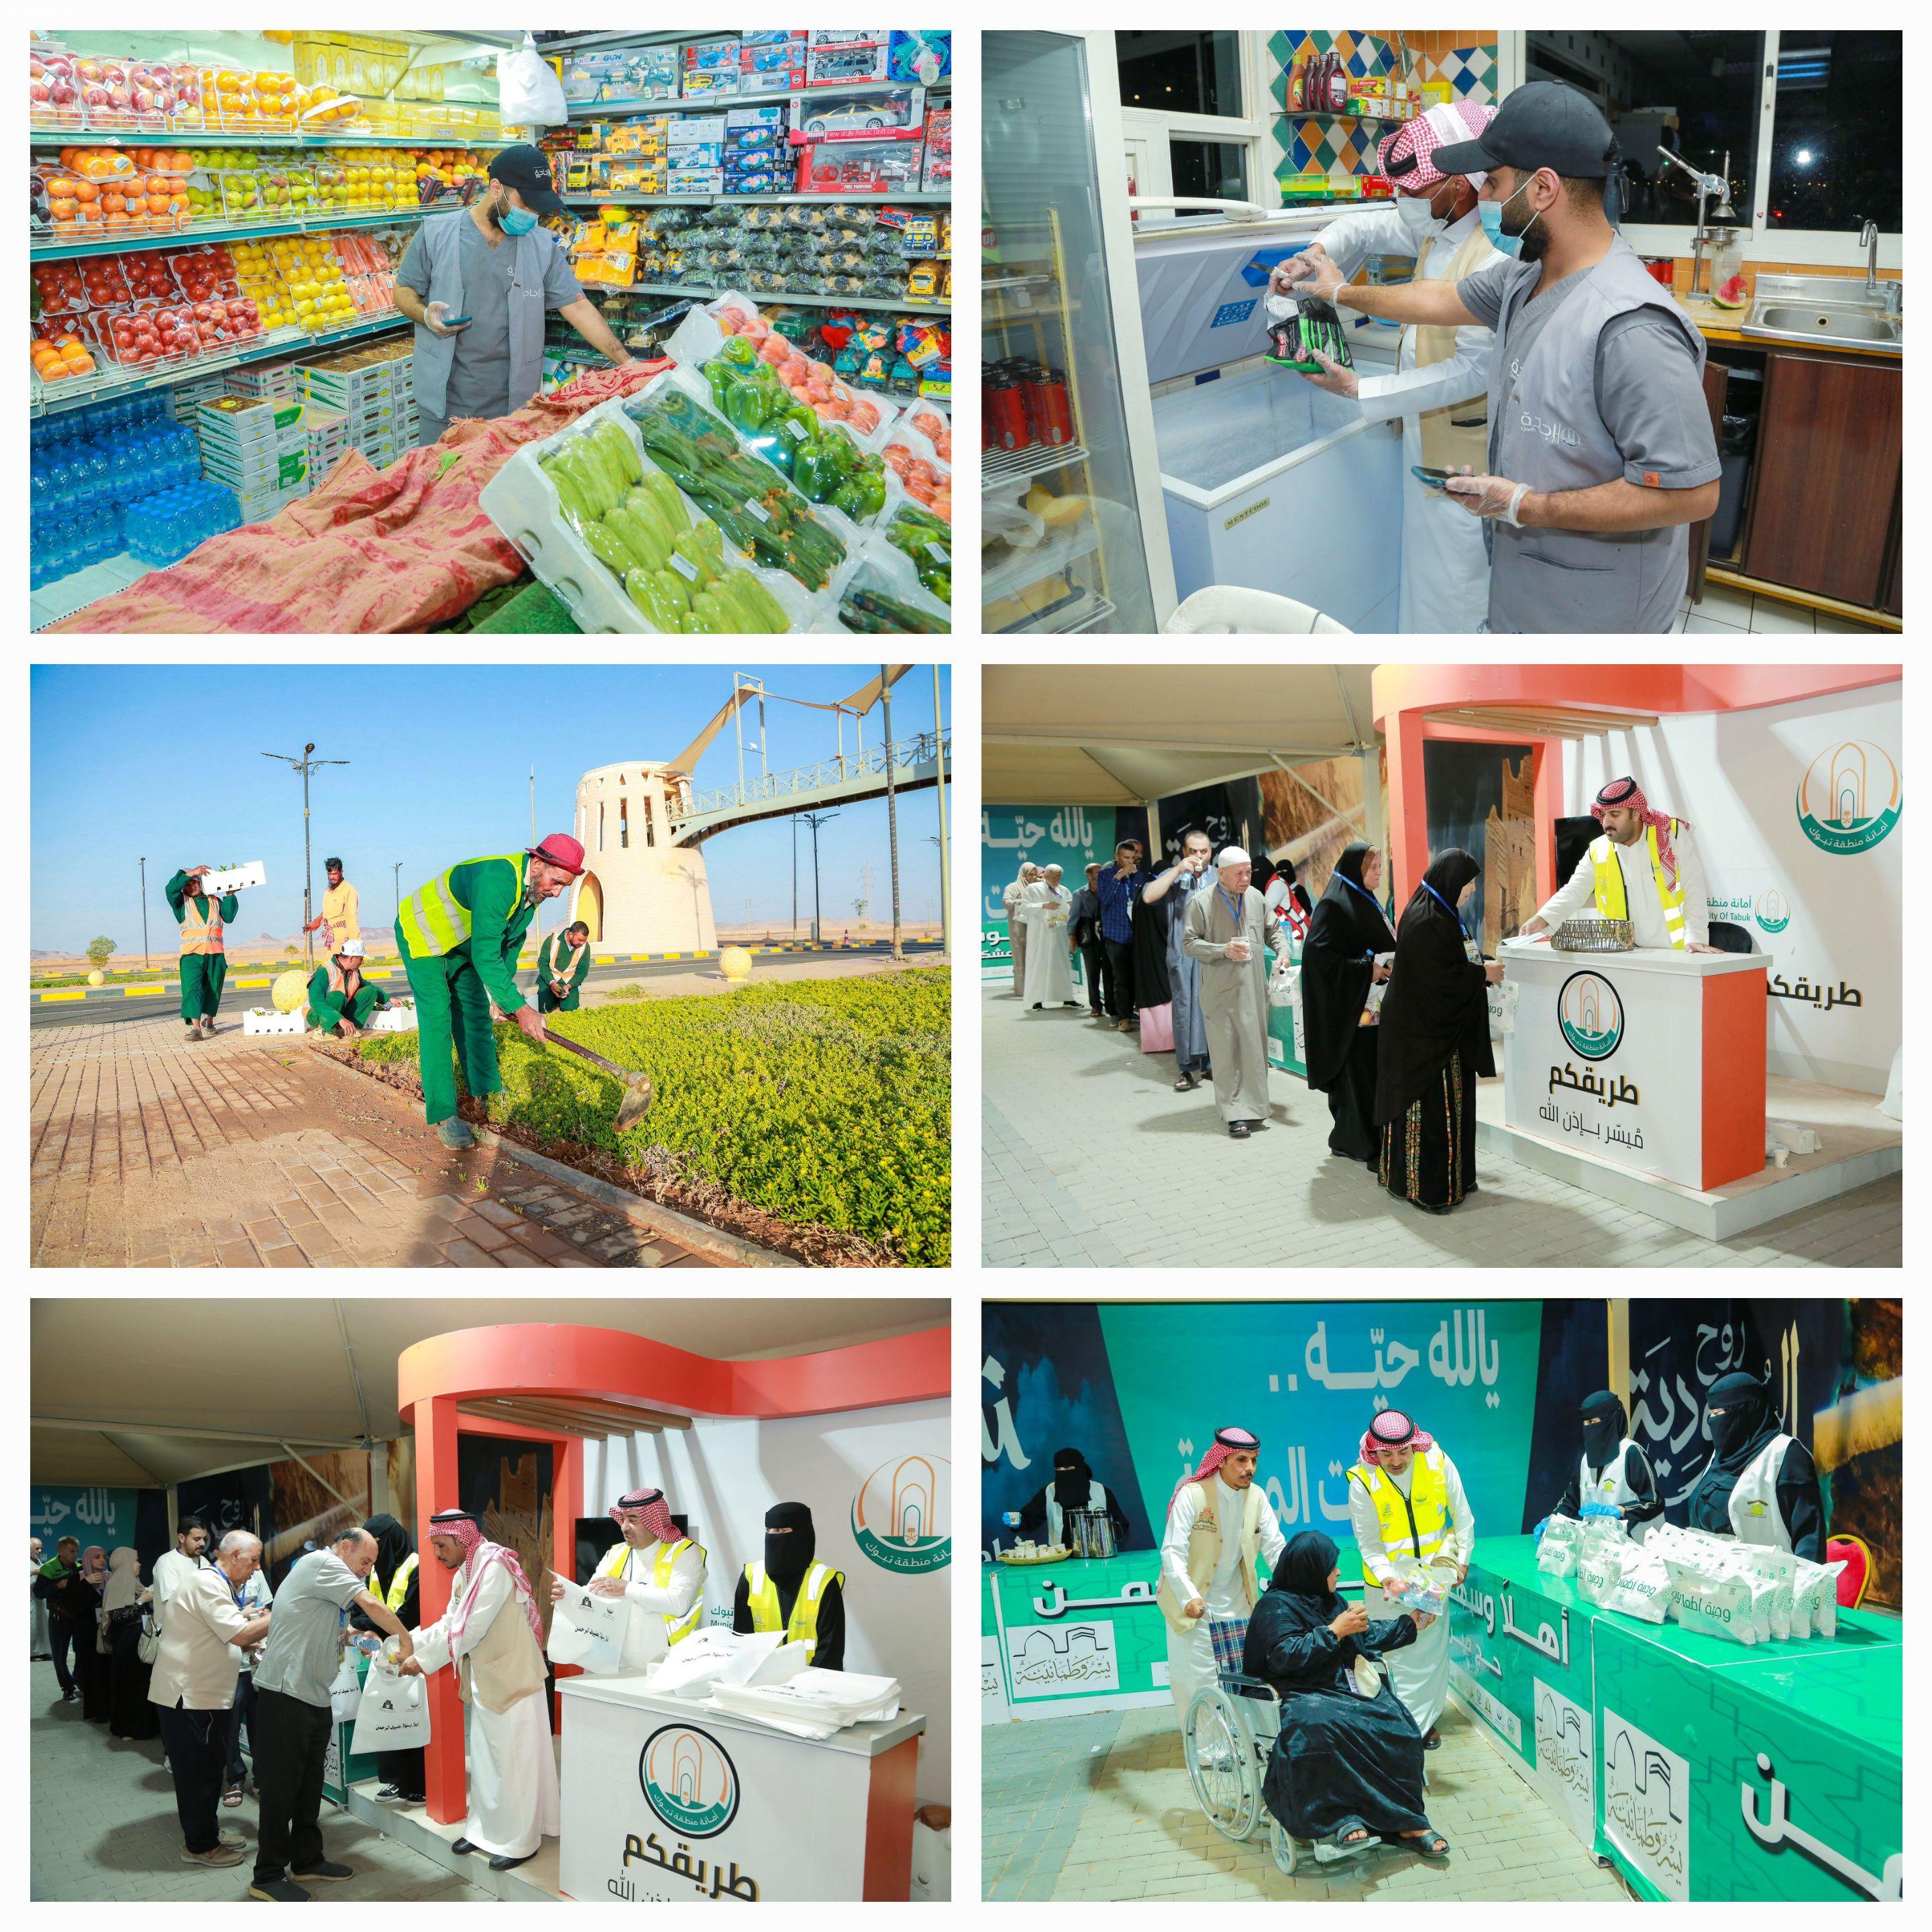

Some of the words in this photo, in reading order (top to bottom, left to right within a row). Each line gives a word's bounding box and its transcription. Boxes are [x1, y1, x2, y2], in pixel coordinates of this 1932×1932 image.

[1809, 825, 1833, 848] تبوك
[1865, 818, 1888, 843] أمانة
[1833, 836, 1864, 849] منطقة
[1731, 895, 1752, 909] أمانة
[1719, 912, 1729, 920] Of
[1730, 912, 1751, 922] Tabuk
[1767, 974, 1864, 1011] طريقك
[1568, 1030, 1583, 1046] تبوك
[1582, 1042, 1599, 1051] منطقة
[1599, 1035, 1612, 1050] أمانة
[1548, 1062, 1641, 1108] طريقكم
[1539, 1096, 1560, 1124] الله
[1428, 1308, 1501, 1409] يالله
[865, 1542, 894, 1563] تبوك
[894, 1555, 930, 1567] منطقة
[1587, 1570, 1604, 1589] وجبة
[1637, 1580, 1657, 1598] وجبة
[711, 1605, 735, 1619] تبوك
[1705, 1601, 1731, 1623] وجبة
[654, 1792, 674, 1816] تبوك
[674, 1812, 699, 1826] منطقة
[699, 1809, 719, 1826] أمانة
[623, 1832, 760, 1902] طريقكم
